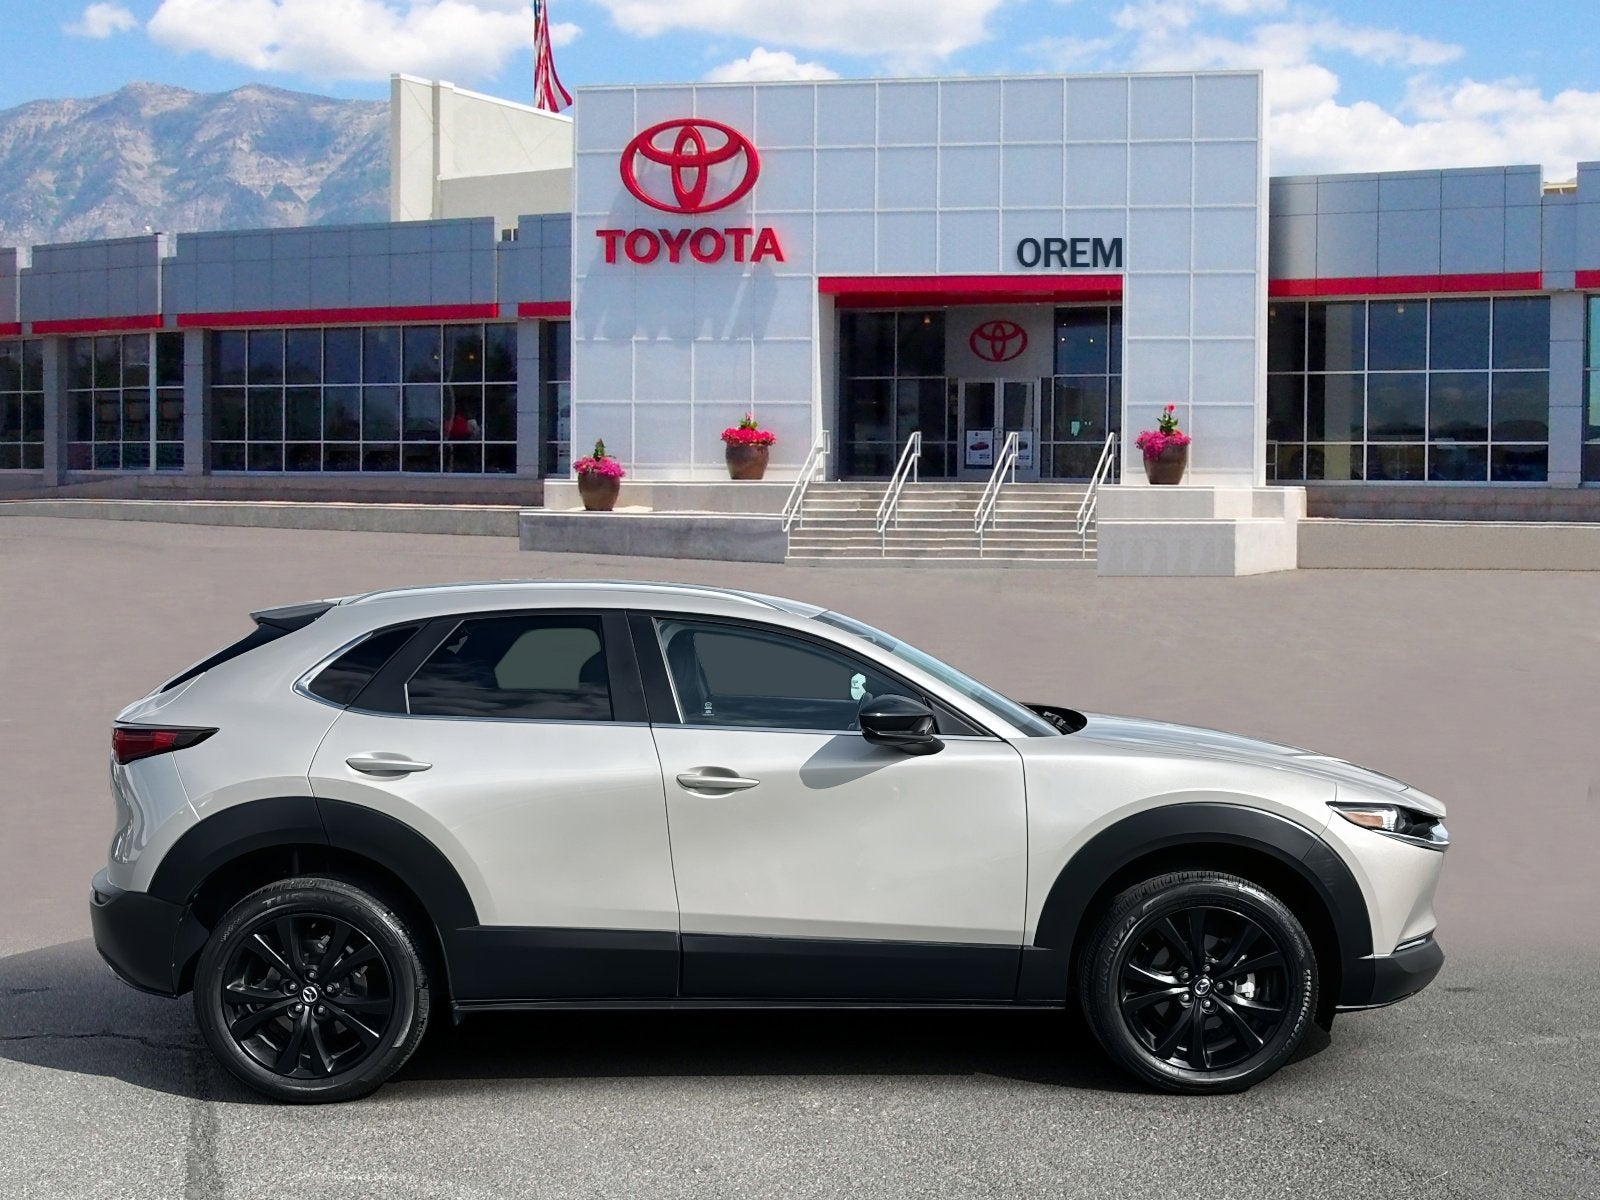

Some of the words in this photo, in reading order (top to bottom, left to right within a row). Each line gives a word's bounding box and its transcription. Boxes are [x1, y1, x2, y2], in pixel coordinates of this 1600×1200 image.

[596, 227, 785, 264] TOYOTA
[1017, 237, 1122, 268] OREM
[1098, 916, 1136, 1000] URANZA
